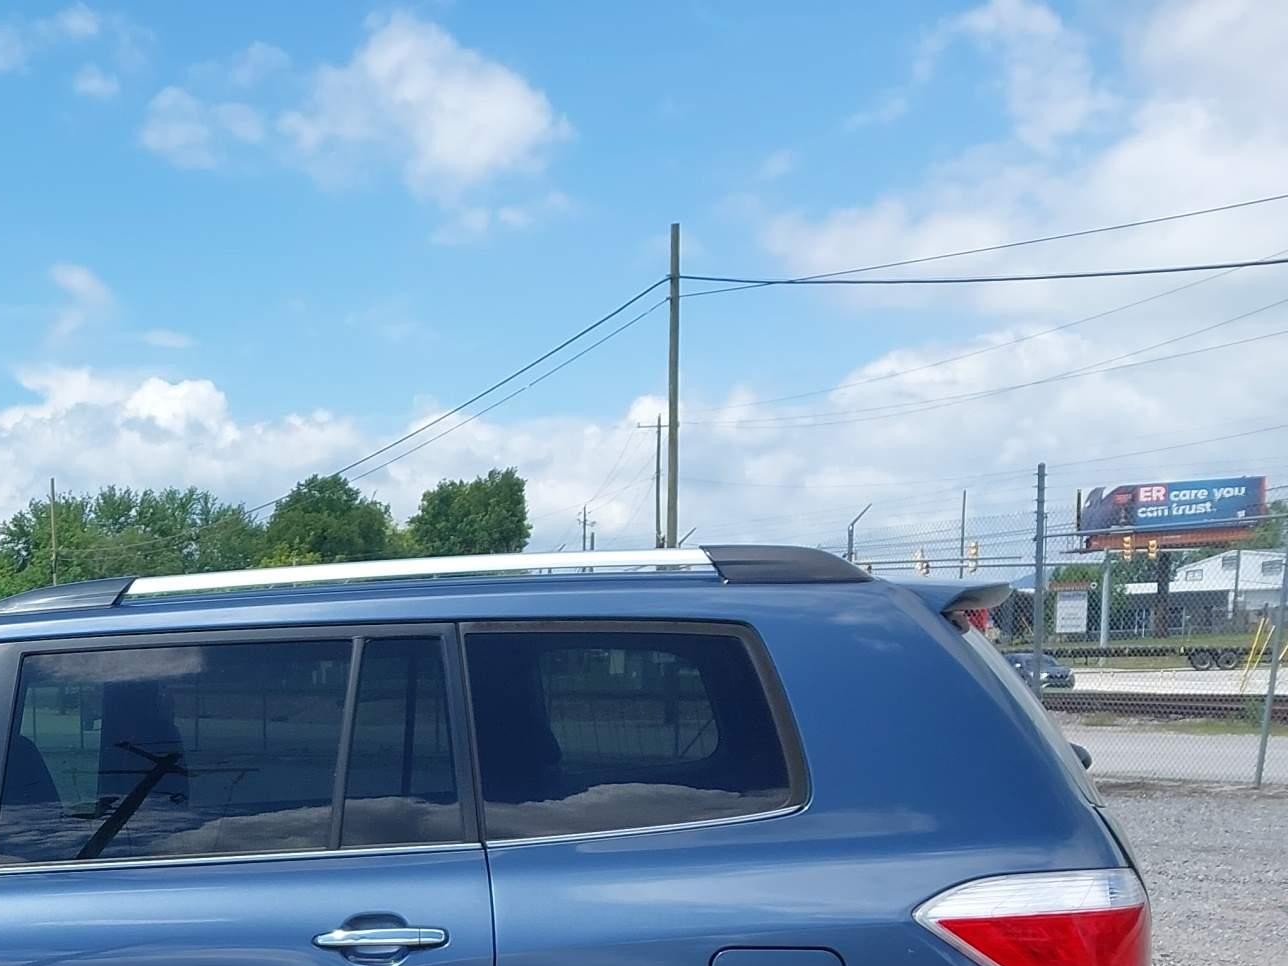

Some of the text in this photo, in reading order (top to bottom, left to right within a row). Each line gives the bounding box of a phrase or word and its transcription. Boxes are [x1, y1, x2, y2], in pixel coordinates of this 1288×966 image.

[1139, 486, 1246, 502] ER care you
[1137, 506, 1169, 518] can
